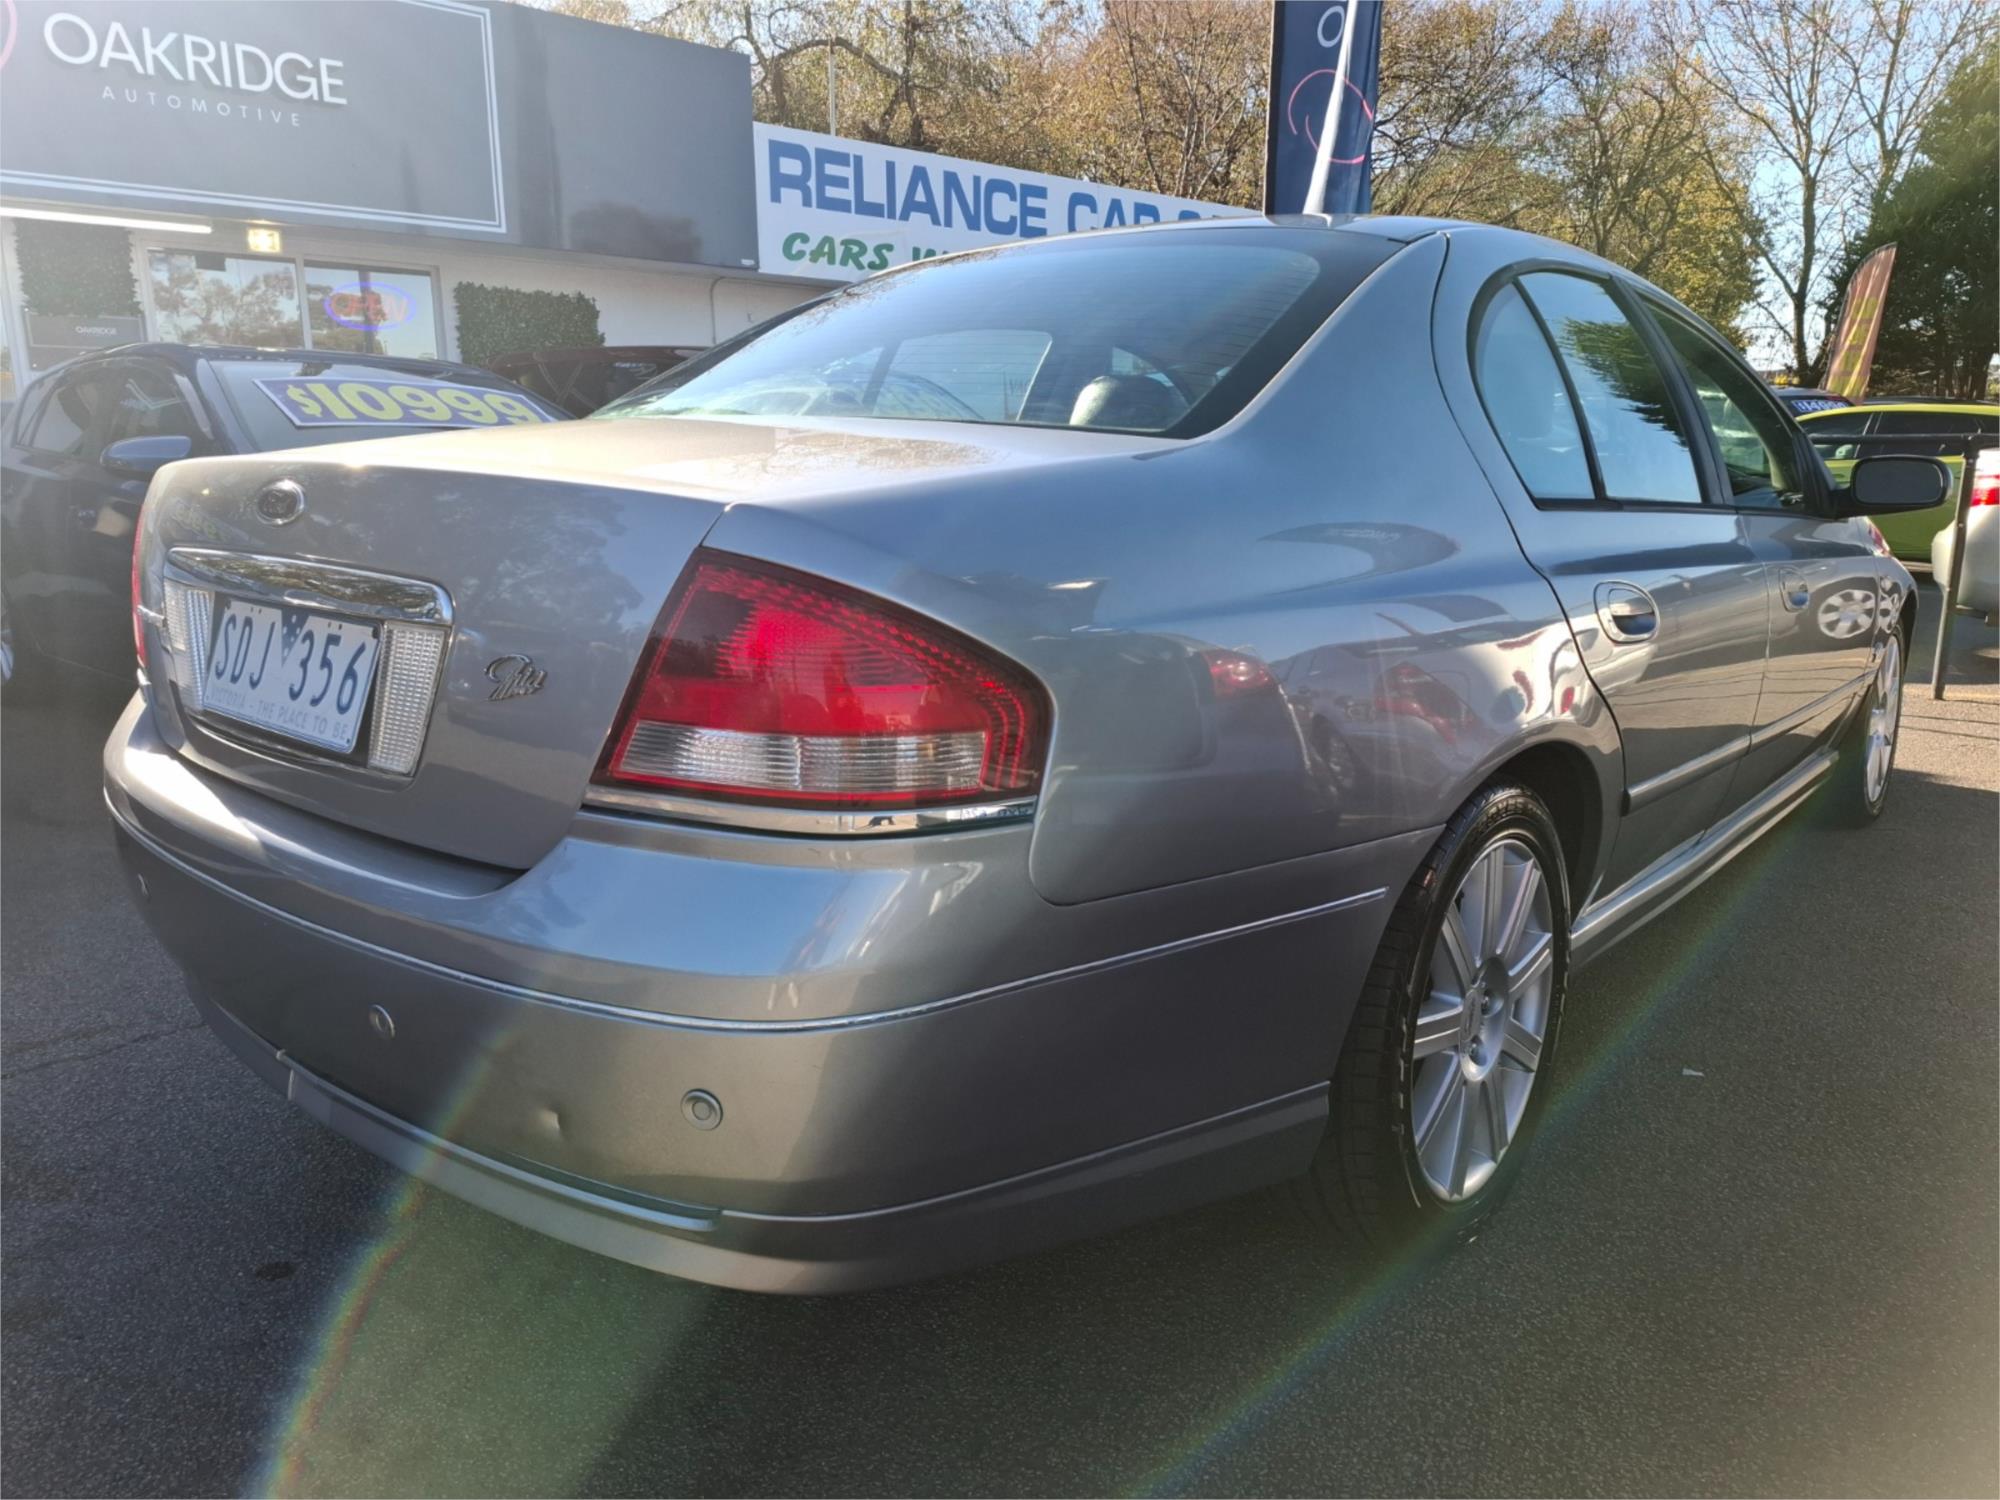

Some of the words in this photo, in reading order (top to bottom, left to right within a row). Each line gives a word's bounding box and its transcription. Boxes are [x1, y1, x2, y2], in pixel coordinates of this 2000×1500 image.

[43, 12, 348, 105] OAKRIDGE
[101, 86, 301, 127] AUTOMOTIVE
[768, 138, 1047, 238] RELIANCE
[782, 231, 895, 271] CARS
[286, 383, 541, 424] $10999
[214, 612, 276, 691] SDJ
[288, 629, 367, 715] 356
[257, 700, 275, 719] THE
[277, 705, 309, 730] PLACE
[312, 714, 328, 734] TO
[331, 721, 350, 740] BE
